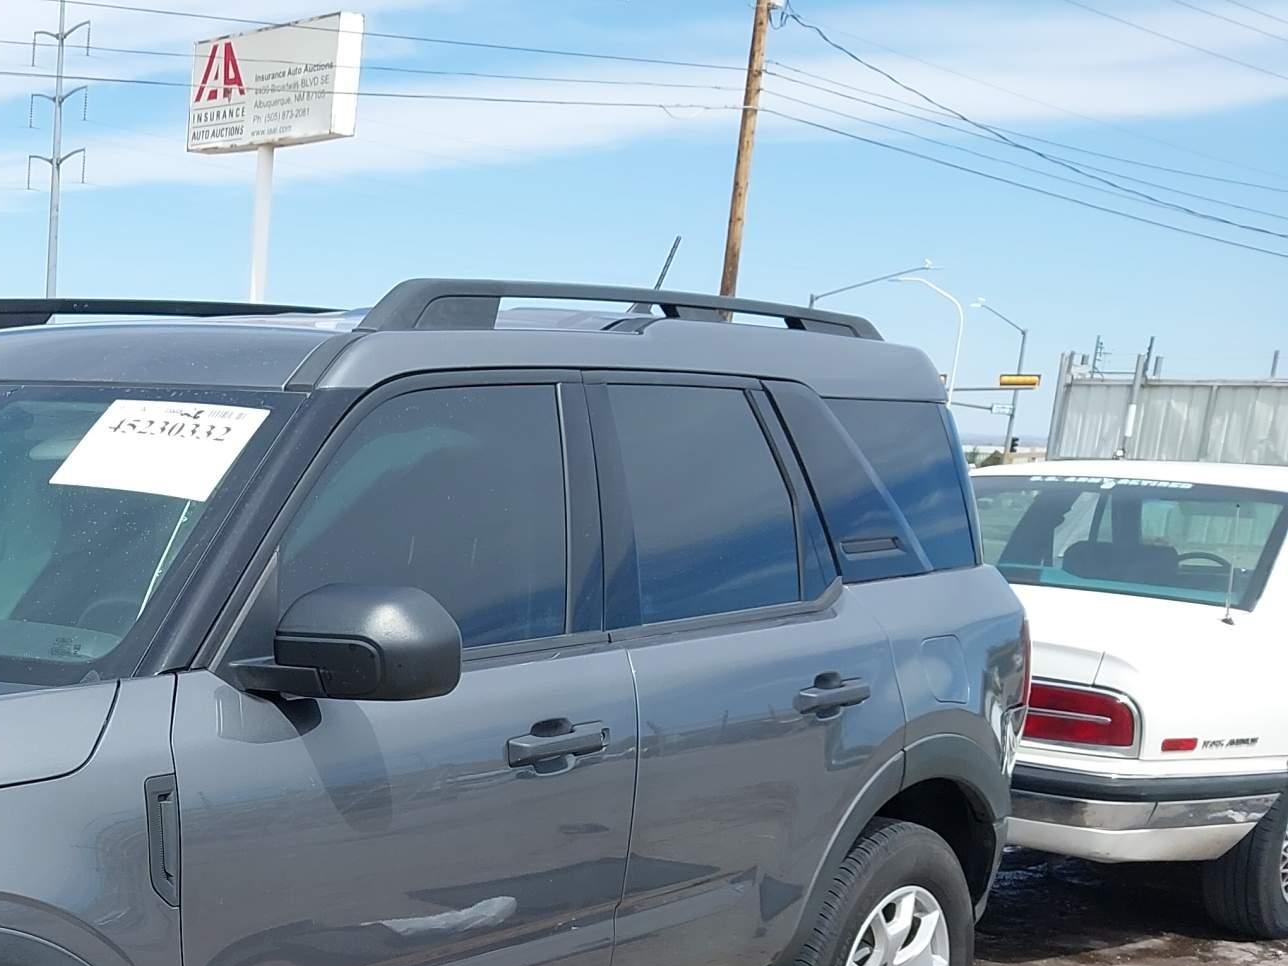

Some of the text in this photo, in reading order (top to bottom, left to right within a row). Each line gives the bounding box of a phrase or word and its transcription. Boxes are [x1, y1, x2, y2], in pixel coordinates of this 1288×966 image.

[255, 62, 333, 82] Insurance Auto Auctions
[300, 76, 319, 88] BLVD
[320, 74, 329, 85] SE
[294, 91, 305, 103] NM
[192, 106, 245, 124] INSURANCE
[192, 125, 244, 141] AUTO AUCTIONS
[109, 418, 232, 441] 45230332
